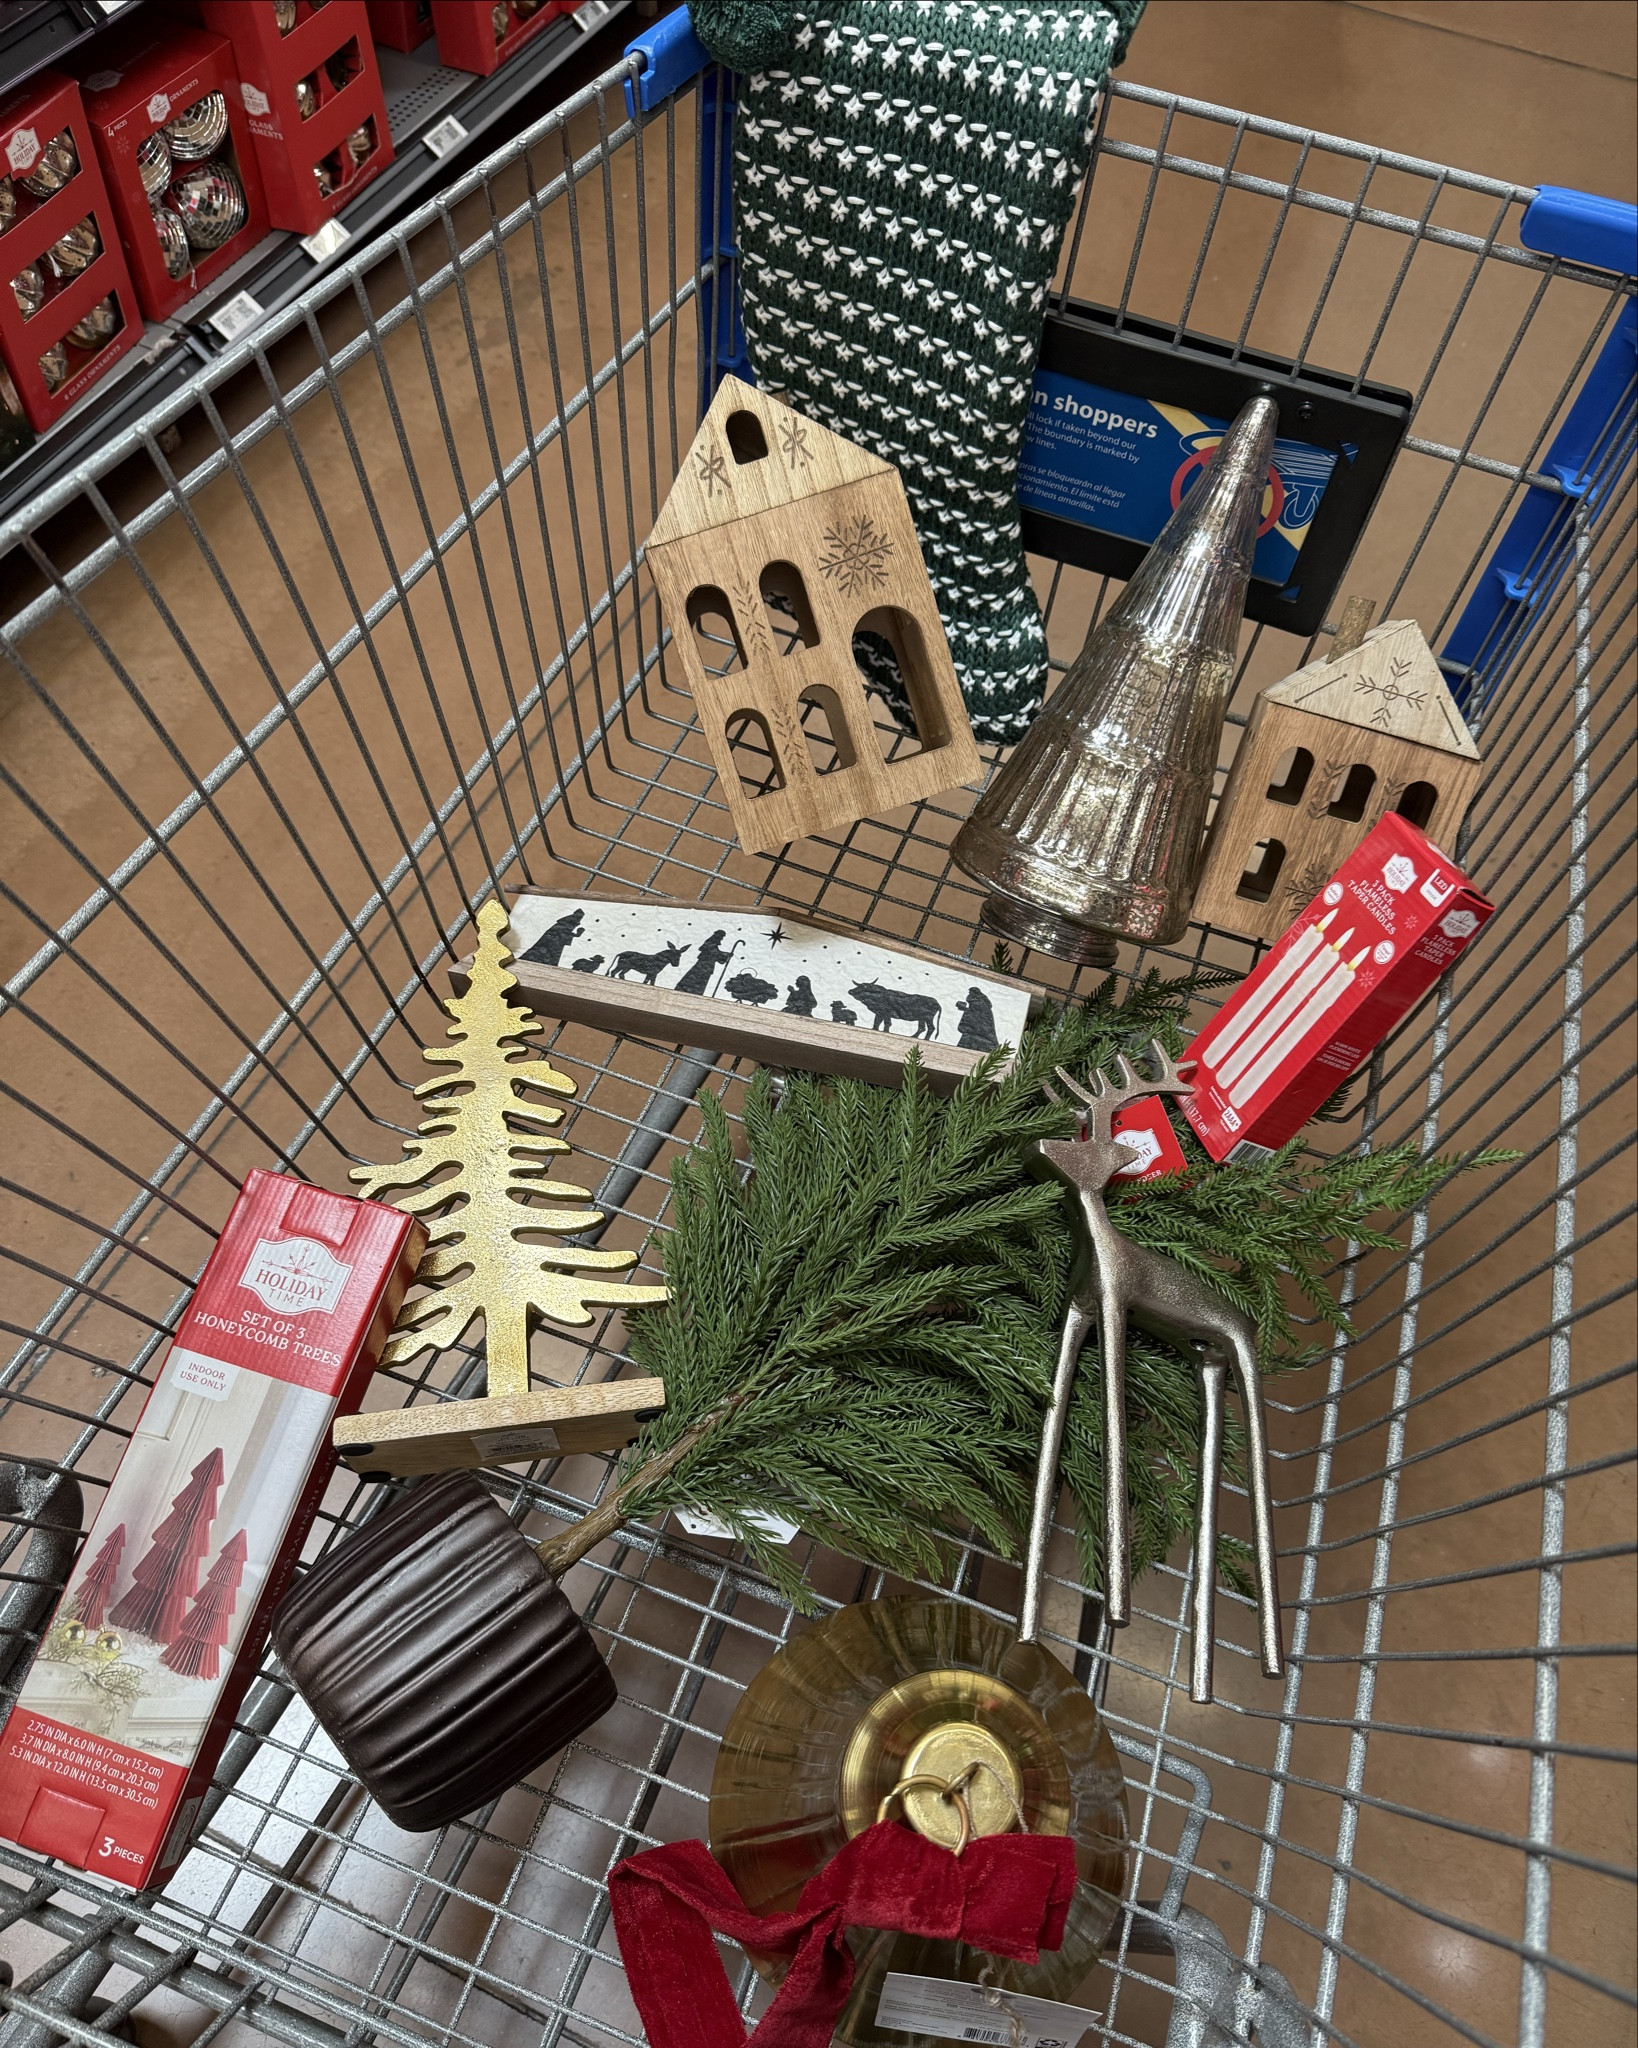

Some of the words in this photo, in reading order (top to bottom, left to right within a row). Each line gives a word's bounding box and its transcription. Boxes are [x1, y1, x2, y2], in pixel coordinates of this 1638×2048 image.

[170, 79, 198, 102] ORNAMENTS
[108, 126, 114, 137] 4
[114, 120, 128, 132] PIECES
[248, 119, 274, 130] GLASS
[13, 144, 36, 165] HOLIDAY
[86, 344, 121, 380] ORNAMENTS
[1031, 390, 1048, 406] n
[1053, 394, 1158, 438] shoppers
[1026, 435, 1034, 444] w
[1036, 436, 1056, 450] lines.
[1028, 422, 1043, 434] The
[1044, 426, 1086, 448] boundary
[1086, 438, 1093, 449] is
[1094, 442, 1128, 460] marked
[1128, 452, 1140, 464] by
[1036, 413, 1053, 426] lock
[1055, 420, 1062, 428] if
[1062, 422, 1086, 436] taken
[1087, 428, 1120, 446] beyond
[1121, 440, 1136, 450] our
[1018, 473, 1068, 492] cionamiento.
[1071, 487, 1078, 496] El
[1019, 462, 1036, 472] pras
[1038, 466, 1046, 475] se
[1093, 483, 1102, 492] al
[1102, 485, 1126, 499] llegar
[1023, 483, 1033, 492] de
[1058, 494, 1096, 512] amarillas.
[1386, 868, 1406, 888] HOLIDAY
[1434, 876, 1448, 891] LED
[1360, 880, 1396, 920] FLAMELESS
[1377, 884, 1396, 905] PACK
[1348, 880, 1368, 905] TAPER
[1366, 902, 1396, 936] CANDLES
[1444, 920, 1468, 934] HOLIDAY
[1420, 936, 1456, 956] FLAMELESS
[1424, 946, 1445, 958] TAPER
[1437, 936, 1454, 948] PACK
[1414, 950, 1443, 966] CANDLES
[1188, 1104, 1202, 1122] (17.7
[1198, 1122, 1210, 1136] cm)
[1127, 1158, 1147, 1170] TIME
[256, 1268, 328, 1301] HOLIDAY
[268, 1288, 304, 1307] TIME
[241, 1310, 272, 1327] SET
[274, 1320, 294, 1336] OF
[296, 1327, 306, 1339] 3
[194, 1312, 289, 1350] HONEYCOMB
[292, 1341, 342, 1366] TREES
[180, 1370, 198, 1382] USE
[200, 1377, 226, 1391] ONLY
[188, 1362, 226, 1380] INDOOR
[273, 1490, 319, 1596] HONEYCOMB
[249, 1602, 274, 1658] TREES
[20, 1732, 33, 1746] 3.7
[32, 1738, 42, 1750] IN
[42, 1740, 56, 1754] DIA
[56, 1748, 62, 1757] x
[62, 1748, 76, 1762] 8.0
[76, 1753, 86, 1765] IN
[86, 1756, 92, 1766] H
[92, 1759, 108, 1774] (9.4
[107, 1766, 120, 1777] cm
[120, 1770, 126, 1780] x
[126, 1770, 144, 1787] 20.3
[143, 1778, 160, 1794] cm)
[27, 1720, 45, 1734] 2.75
[44, 1725, 54, 1738] IN
[54, 1728, 68, 1742] DIA
[68, 1735, 74, 1744] x
[73, 1736, 86, 1749] 6.0
[87, 1741, 96, 1752] IN
[96, 1744, 103, 1755] H
[104, 1747, 112, 1760] (7
[112, 1752, 124, 1763] cm
[124, 1756, 130, 1766] x
[131, 1757, 148, 1772] 15.2
[148, 1764, 164, 1780] cm)
[10, 1745, 22, 1758] 5.3
[22, 1750, 32, 1762] IN
[32, 1753, 46, 1767] DIA
[46, 1760, 52, 1770] x
[52, 1760, 69, 1776] 12.0
[69, 1766, 79, 1780] IN
[79, 1771, 86, 1782] H
[86, 1772, 106, 1790] (13.5
[106, 1780, 119, 1792] cm
[118, 1786, 124, 1796] x
[126, 1786, 142, 1802] 30.5
[142, 1794, 159, 1810] cm)
[98, 1836, 115, 1857] 3
[113, 1845, 144, 1865] PIECES
